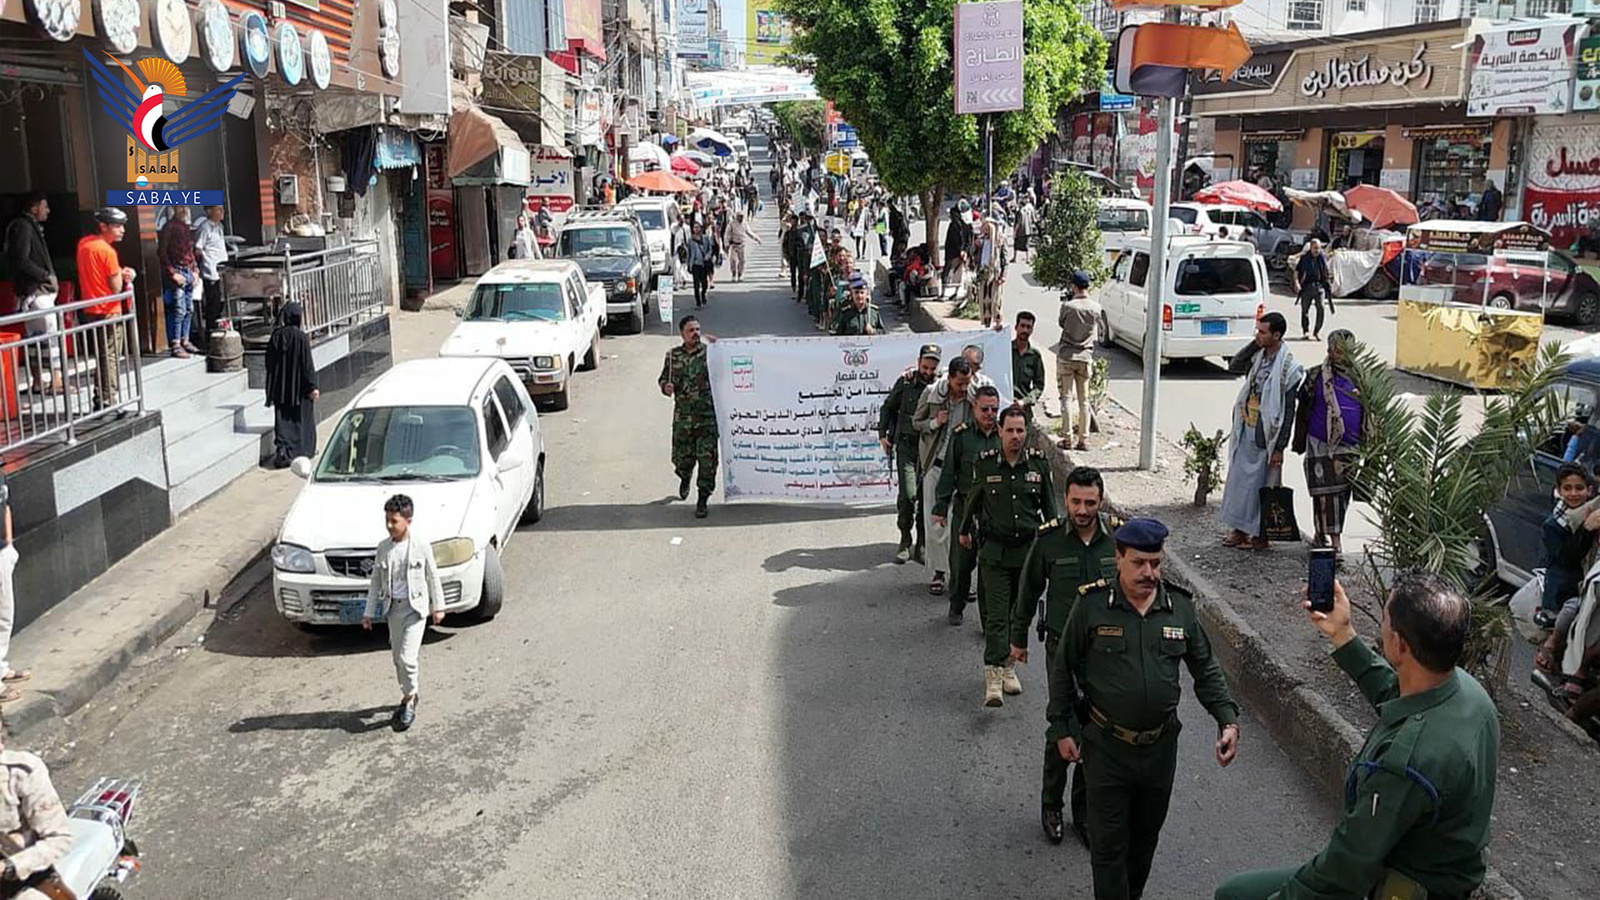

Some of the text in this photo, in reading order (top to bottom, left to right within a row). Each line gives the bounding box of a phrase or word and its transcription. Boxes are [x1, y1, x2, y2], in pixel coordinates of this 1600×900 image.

[965, 46, 1020, 67] الطازج
[1481, 50, 1518, 68] السرية
[1518, 46, 1561, 64] النكهة
[1301, 42, 1433, 98] ركن مملكة البن
[1546, 146, 1600, 178] عسل
[834, 369, 880, 384] تحت شعار
